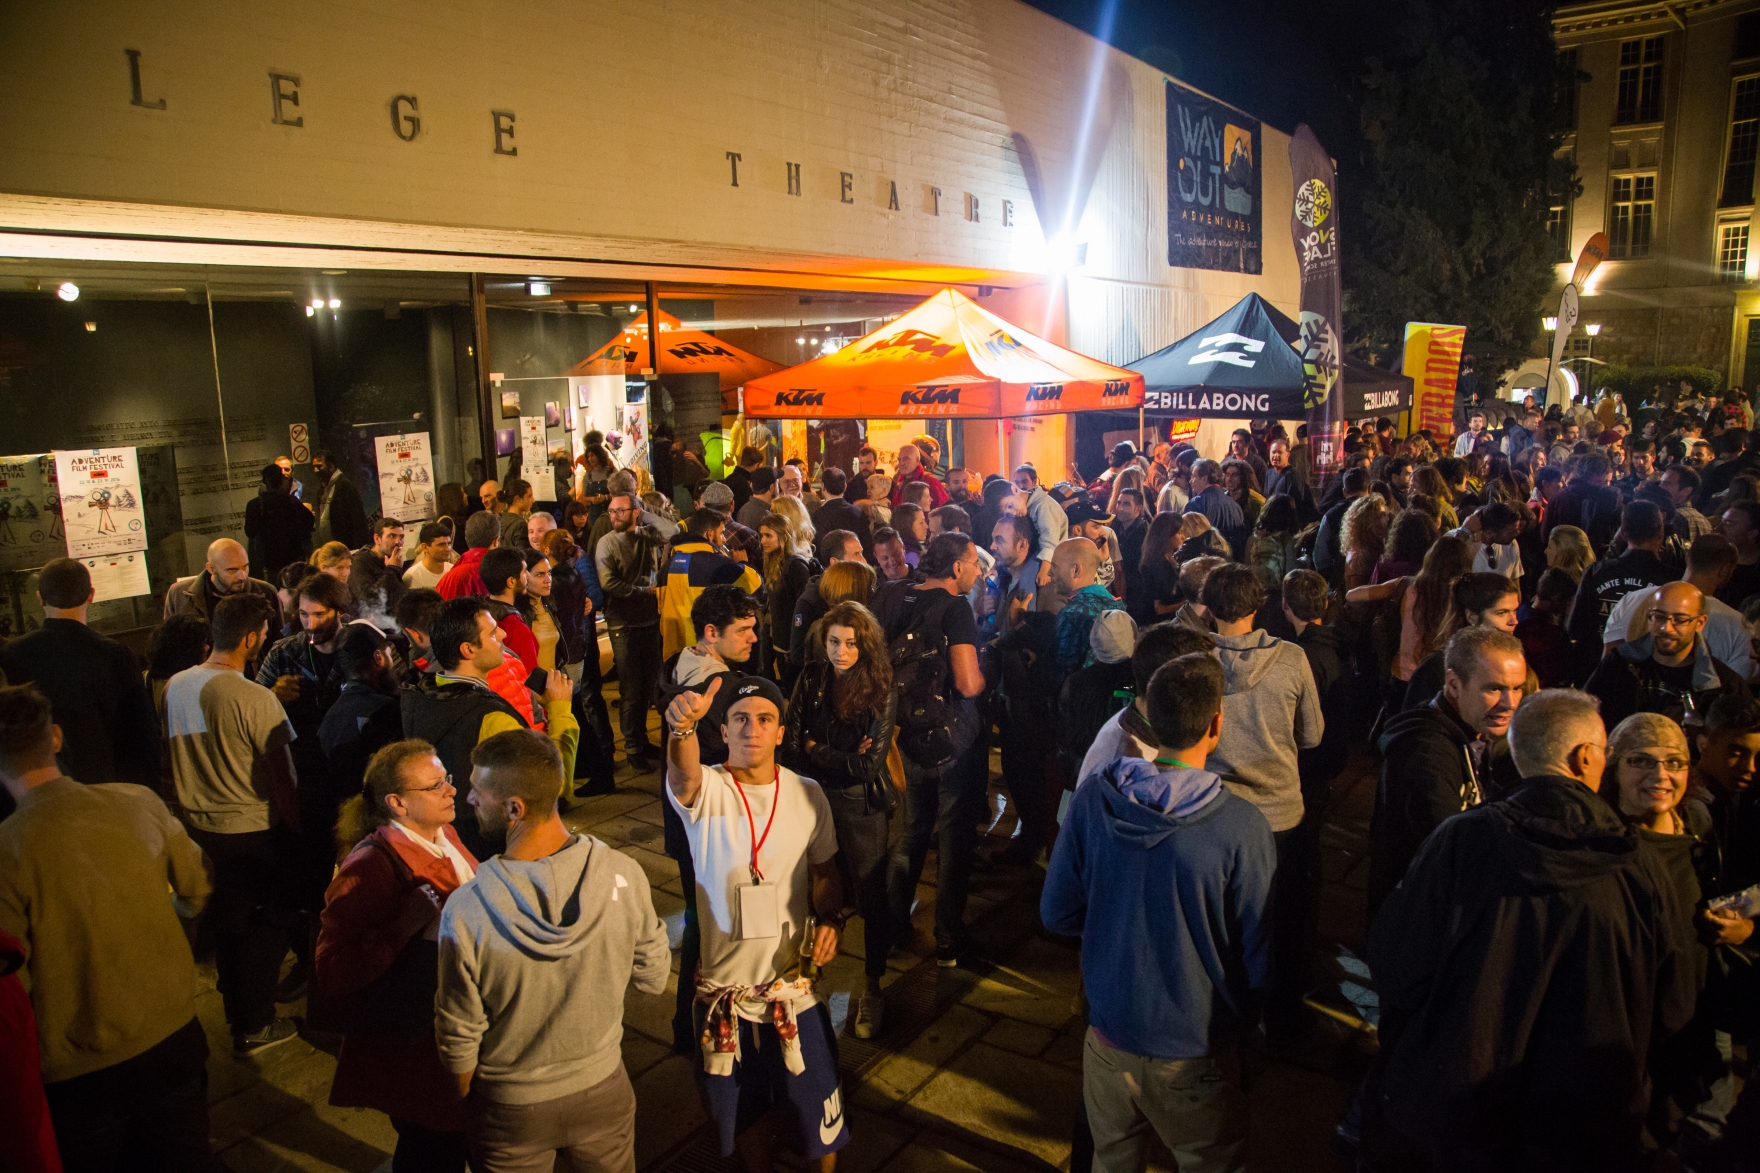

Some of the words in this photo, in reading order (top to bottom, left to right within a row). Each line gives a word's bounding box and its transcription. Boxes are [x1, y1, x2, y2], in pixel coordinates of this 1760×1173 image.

[1177, 104, 1222, 162] WAY
[725, 151, 1015, 228] THEATRE
[1178, 157, 1221, 208] OUT
[774, 388, 826, 406] KTM
[900, 385, 962, 405] KTM
[1025, 382, 1064, 402] KTM
[1101, 379, 1131, 398] KTM
[1161, 392, 1270, 412] BILLABONG
[1371, 389, 1399, 410] BILLABONG
[896, 404, 959, 415] RACING
[385, 439, 422, 449] ADVENTURE
[71, 455, 123, 466] ADVENTURE
[89, 463, 125, 471] FESTIVAL
[1596, 578, 1620, 594] DANTE
[1624, 577, 1643, 587] WILL
